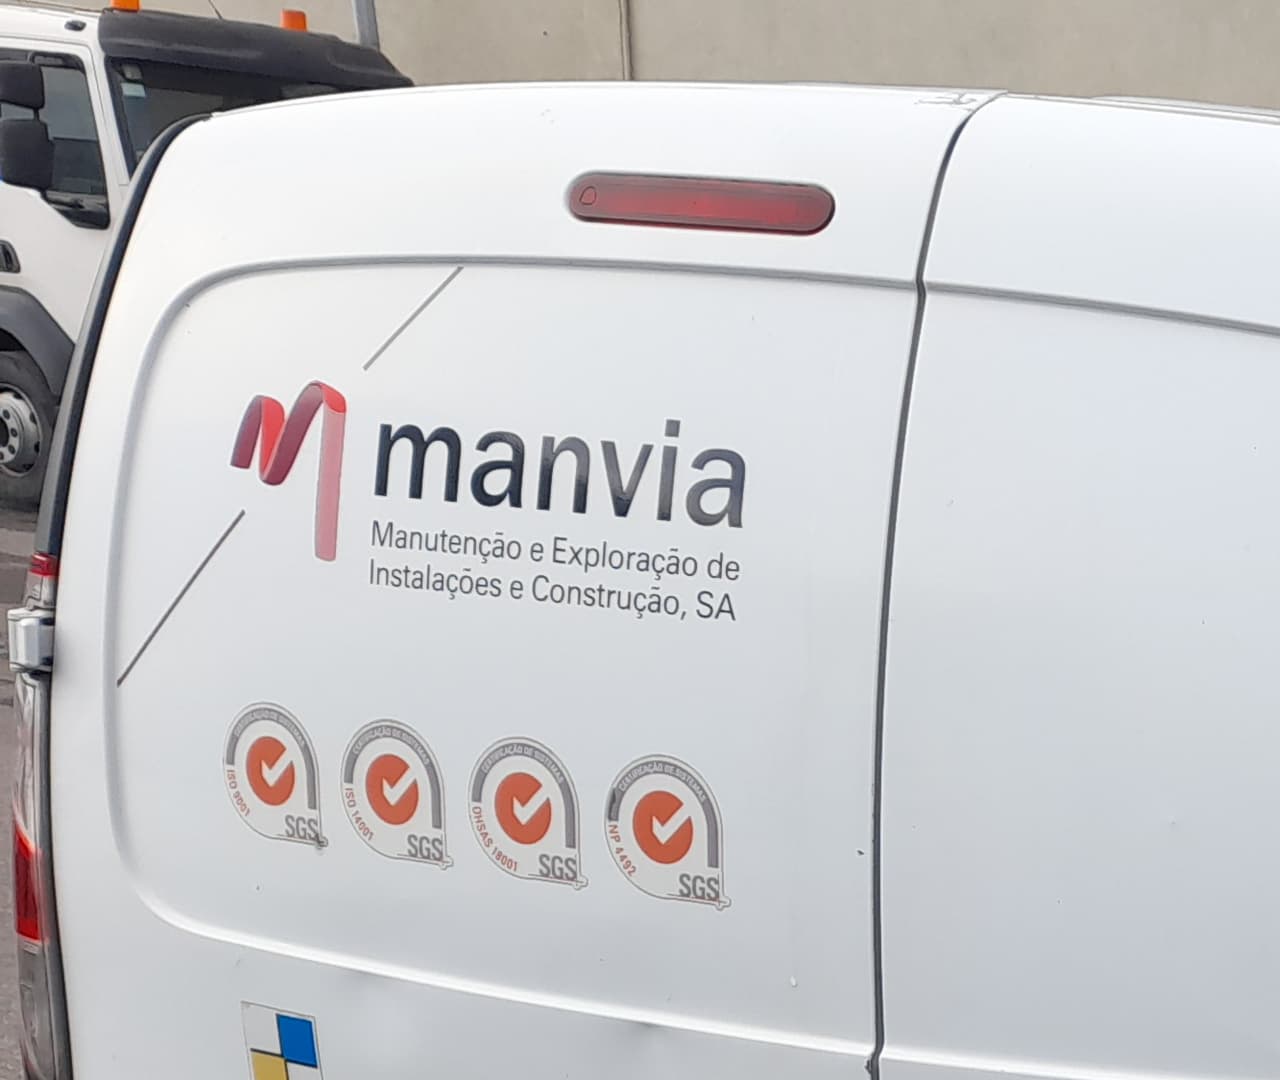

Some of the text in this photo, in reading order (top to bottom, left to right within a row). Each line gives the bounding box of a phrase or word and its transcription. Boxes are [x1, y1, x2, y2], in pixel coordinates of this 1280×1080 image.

[373, 419, 747, 528] manvia
[370, 520, 741, 582] Manutenção e Exploração de
[369, 558, 736, 621] Instalações e Construção, SA
[226, 768, 251, 817] ISO 9001
[345, 787, 374, 842] ISO 14001
[285, 814, 319, 841] SGS
[407, 834, 443, 861] SGS
[472, 806, 519, 872] OHSAS 18001
[608, 823, 637, 877] NP 4492
[539, 853, 577, 882] SGS
[679, 873, 720, 902] SGS
